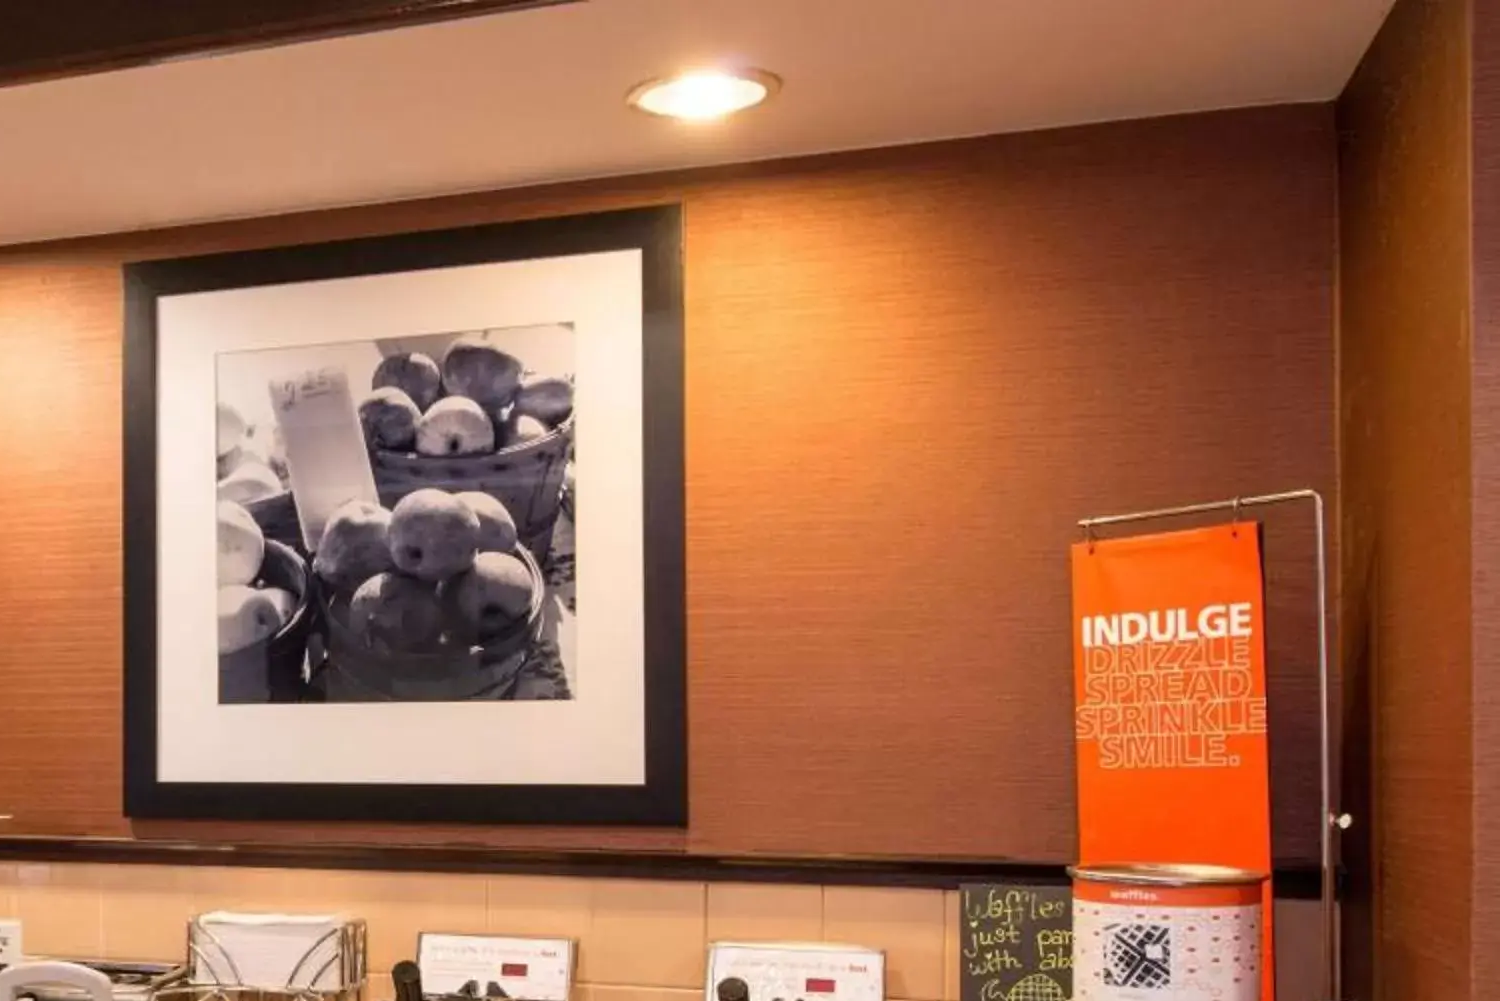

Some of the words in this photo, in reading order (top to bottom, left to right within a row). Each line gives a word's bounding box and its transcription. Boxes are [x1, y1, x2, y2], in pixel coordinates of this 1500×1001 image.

[1082, 602, 1252, 648] INDULGE
[1086, 636, 1252, 678] DRIZZLE
[1086, 668, 1252, 706] SPREAD
[1075, 697, 1267, 739] SPRINKLE
[1099, 731, 1241, 769] SMILE.
[963, 889, 1067, 926] Waffles
[963, 921, 1021, 958] just
[968, 949, 1023, 976] with
